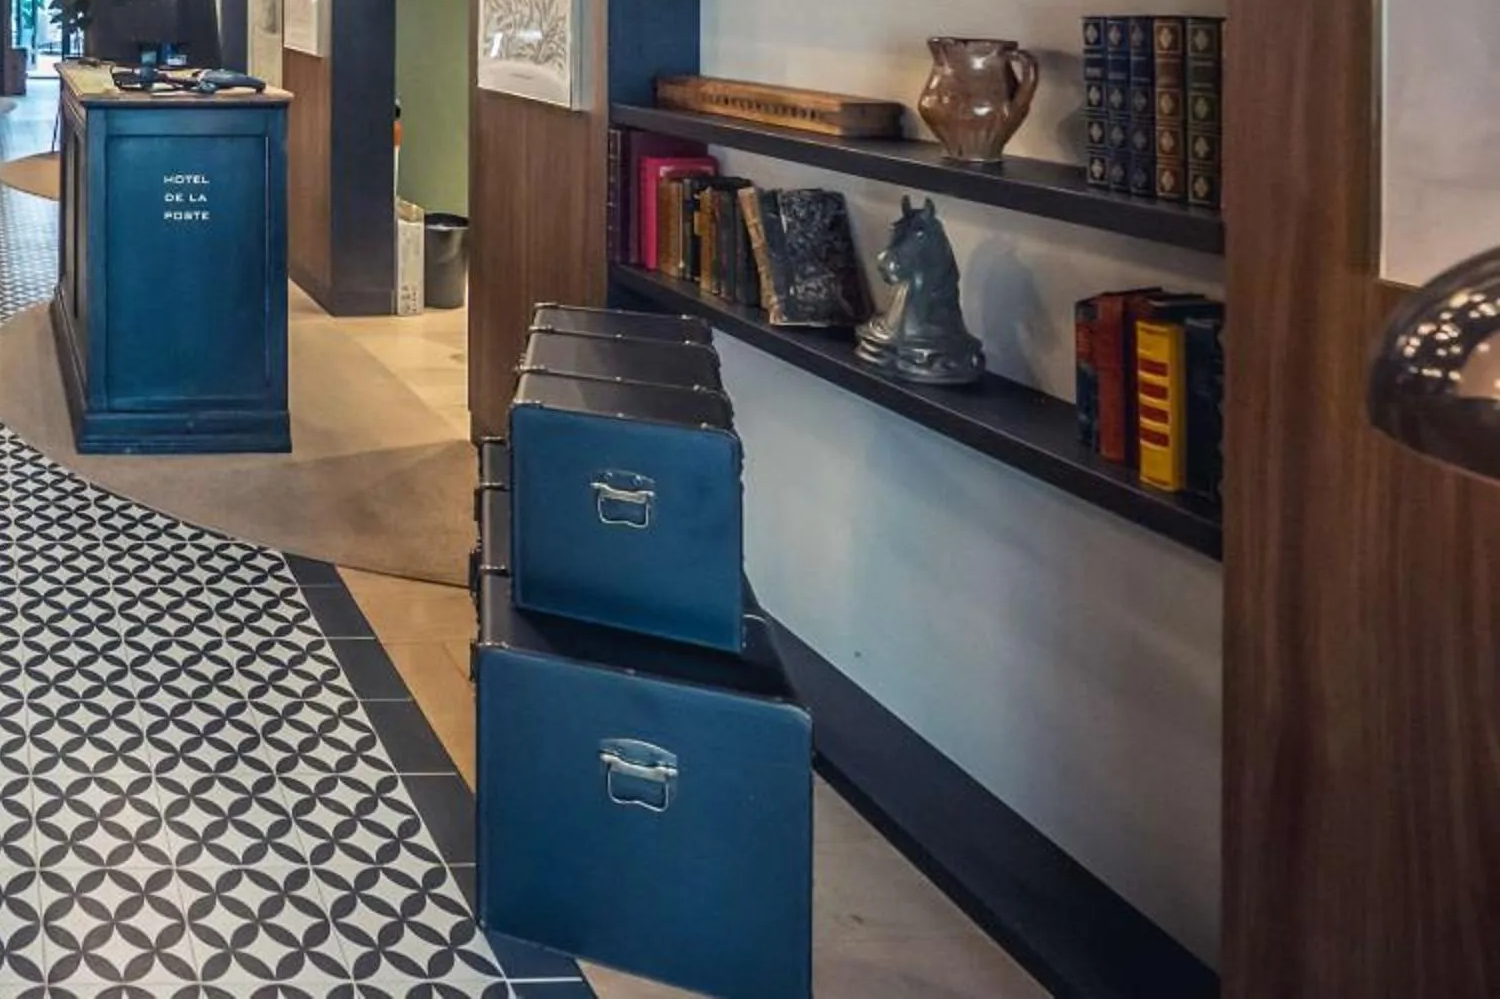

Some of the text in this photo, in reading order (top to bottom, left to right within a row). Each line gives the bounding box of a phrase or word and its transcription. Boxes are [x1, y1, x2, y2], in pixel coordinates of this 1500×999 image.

[163, 174, 210, 184] HOTEL
[163, 193, 208, 202] DE LA
[163, 211, 210, 220] POSTE
